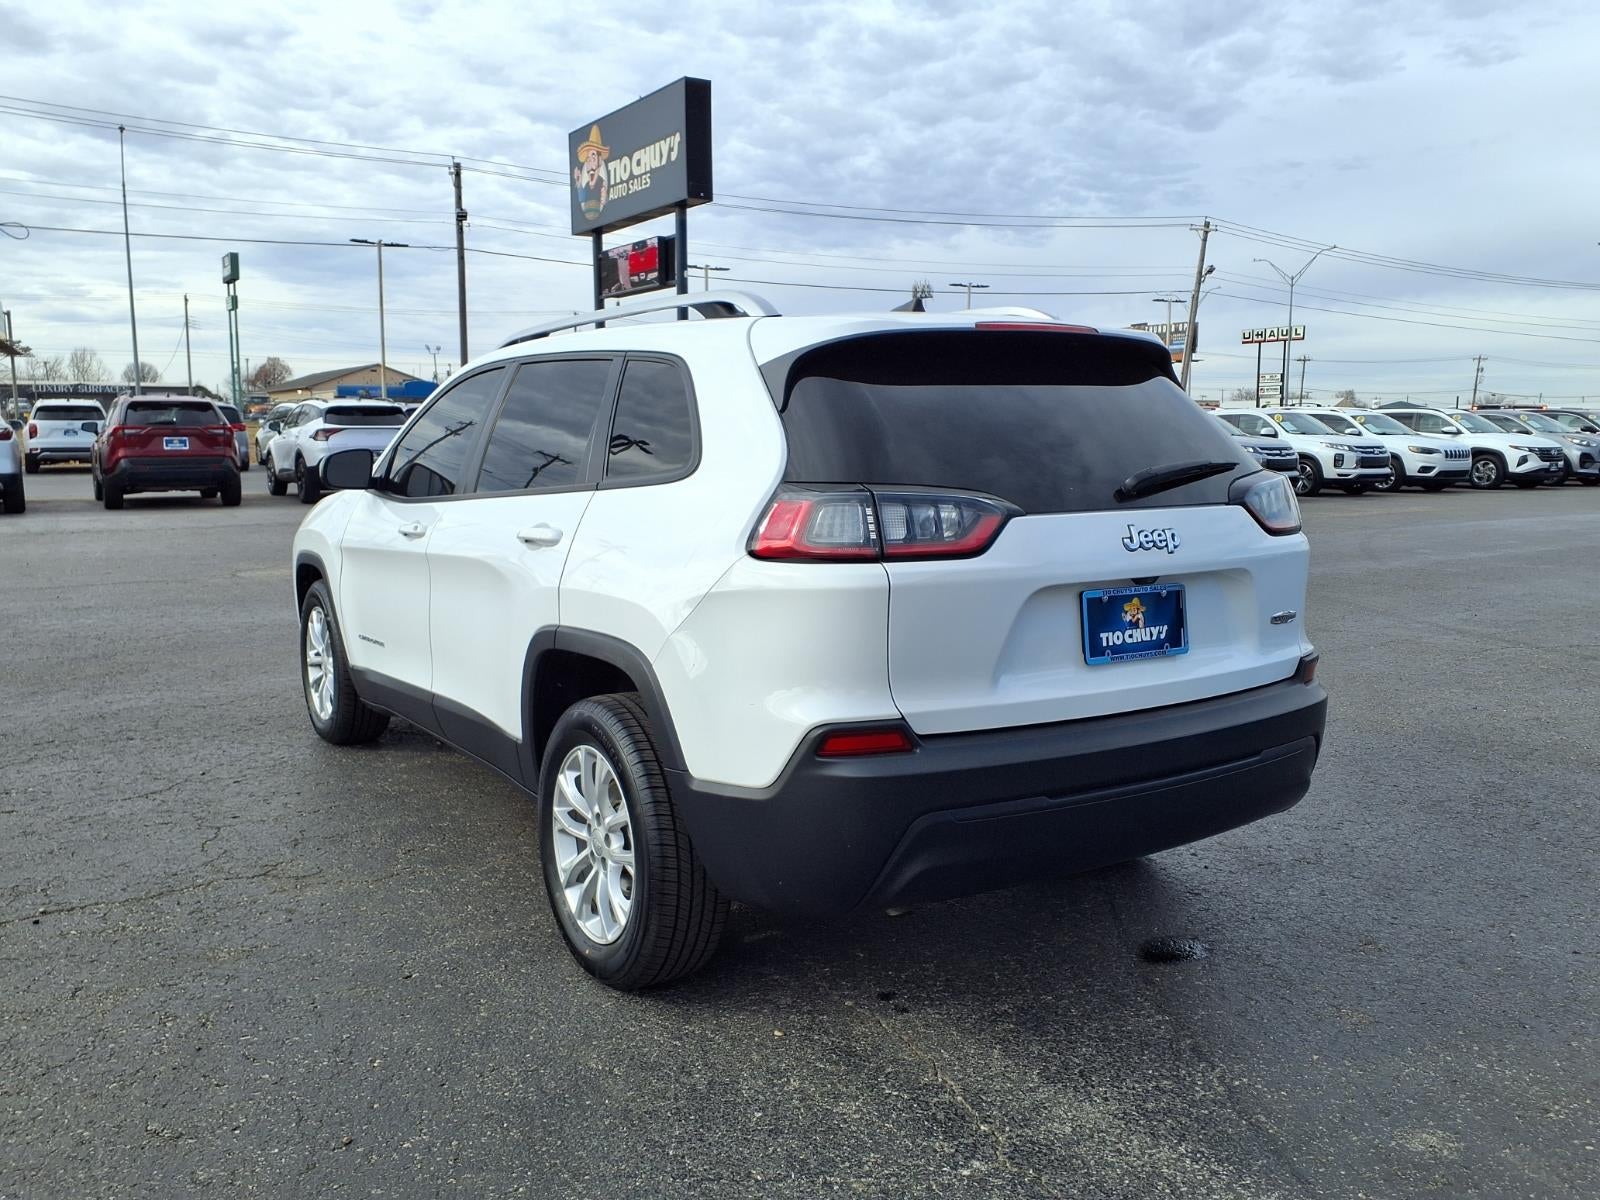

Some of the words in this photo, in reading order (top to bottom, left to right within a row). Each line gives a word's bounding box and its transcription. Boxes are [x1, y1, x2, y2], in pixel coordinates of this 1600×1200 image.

[608, 156, 631, 185] TIO
[632, 132, 681, 176] CHUY'S
[609, 183, 628, 201] AUTO
[629, 173, 651, 194] SALES
[32, 384, 74, 393] LUXURY
[1122, 524, 1181, 554] Jeep
[1134, 585, 1149, 593] AUTO
[1150, 583, 1168, 591] SALES
[1100, 631, 1123, 647] TIO
[1124, 624, 1168, 643] CHUY'S
